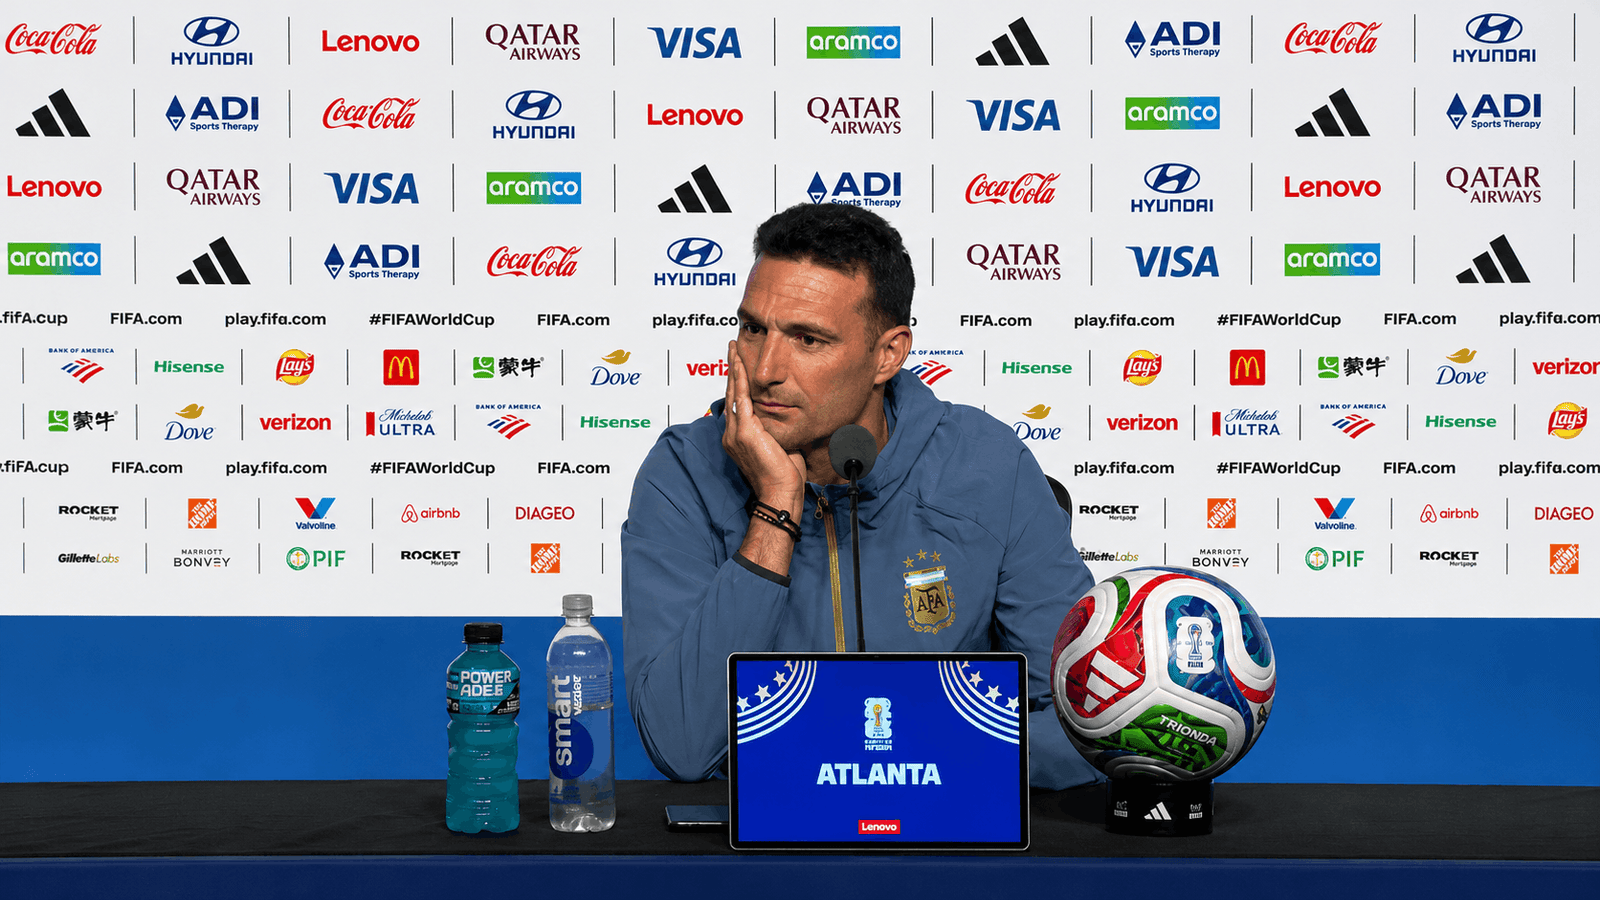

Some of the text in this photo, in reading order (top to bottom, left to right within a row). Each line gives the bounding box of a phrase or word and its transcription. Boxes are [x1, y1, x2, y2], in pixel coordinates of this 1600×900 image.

[5, 23, 102, 55] Coca-Cola
[322, 30, 420, 52] Lenovo
[486, 24, 579, 47] QATAR
[1150, 21, 1220, 46] ADI
[1285, 22, 1382, 54] Coca-Cola
[647, 27, 742, 59] VISA
[809, 34, 898, 51] aramco
[171, 52, 253, 65] HYUNDAI
[510, 48, 580, 60] AIRWAYS
[1150, 48, 1220, 58] Sports Therapy
[1453, 49, 1536, 62] HYUNDAI
[190, 96, 259, 120] ADI
[322, 98, 420, 129] Coca-Cola
[807, 97, 900, 120] QATAR
[1127, 105, 1217, 122] aramco
[1471, 94, 1541, 118] ADI
[648, 104, 743, 126] Lenovo
[966, 99, 1061, 131] VISA
[190, 122, 259, 132] Sports Therapy
[831, 121, 901, 134] AIRWAYS
[1471, 119, 1541, 129] Sports Therapy
[493, 126, 575, 139] HYUNDAI
[167, 169, 260, 192] QATAR
[831, 172, 901, 196] ADI
[1446, 166, 1541, 190] QATAR
[7, 175, 102, 197] Lenovo
[324, 172, 419, 204] VISA
[489, 179, 578, 196] aramco
[965, 173, 1061, 204] Coca-Cola
[1285, 176, 1381, 197] Lenovo
[191, 193, 260, 205] AIRWAYS
[864, 198, 902, 209] Therapy
[1470, 191, 1541, 203] AIRWAYS
[1131, 199, 1213, 212] HYUNDAI
[10, 251, 99, 268] aramco
[349, 244, 419, 268] ADI
[487, 246, 582, 277] Coca-Cola
[967, 244, 1060, 267] QATAR
[1125, 246, 1219, 277] VISA
[1287, 250, 1378, 267] aramco
[349, 270, 419, 280] Sports Therapy
[654, 273, 736, 286] HYUNDAI
[991, 268, 1061, 280] AIRWAYS
[111, 313, 182, 325] FIFA.com
[225, 313, 326, 327] play.fifa.com
[369, 313, 494, 328] #FIFAWorldCup
[538, 314, 610, 326] FIFA.com
[652, 313, 738, 328] play.fifa.co
[961, 315, 1032, 326] FIFA.com
[1075, 314, 1174, 329] play.fifa.com
[1217, 313, 1341, 328] #FIFAWorldCup
[1384, 313, 1456, 325] FIFA.com
[1500, 311, 1600, 327] play.fifa.com
[154, 361, 224, 373] Hisense
[279, 358, 313, 377] Lay's
[499, 357, 541, 378] 蒙牛
[590, 363, 640, 385] Dove
[1002, 362, 1072, 374] Hisense
[1127, 358, 1160, 378] Lay's
[1343, 357, 1386, 377] 蒙牛
[1436, 362, 1486, 385] Dove
[73, 411, 114, 431] 蒙牛
[259, 413, 331, 430] verizon
[379, 409, 433, 422] Michelob
[581, 416, 651, 428] Hisense
[1107, 414, 1178, 431] verizon
[1225, 409, 1279, 422] Michelob
[1426, 415, 1496, 427] Hisense
[1552, 412, 1585, 430] Lay's
[164, 421, 214, 440] Dove
[380, 424, 435, 436] ULTRA
[1015, 420, 1062, 441] Dove
[1226, 424, 1280, 436] ULTRA
[112, 462, 182, 473] FIFA.com
[226, 461, 327, 476] play.fifa.com
[370, 462, 495, 476] #FIFAWorldCup
[538, 462, 610, 474] FIFA.com
[1074, 462, 1174, 476] play.fifa.com
[1217, 461, 1341, 476] #FIFAWorldCup
[1384, 462, 1455, 474] FIFA.com
[1499, 461, 1600, 477] play.fifa.com
[59, 506, 119, 514] ROCKET
[421, 507, 460, 518] airbnb
[516, 506, 575, 520] DIAGEO
[1079, 505, 1139, 516] ROCKET
[1440, 508, 1479, 518] airbnb
[1535, 507, 1594, 520] DIAGEO
[296, 522, 336, 530] Valvoline
[1315, 522, 1355, 530] Valvoline
[313, 550, 346, 567] PIF
[401, 551, 461, 560] ROCKET
[1332, 551, 1364, 567] PIF
[1420, 551, 1479, 560] ROCKET
[460, 671, 512, 684] POWER
[555, 675, 572, 766] smart
[1160, 714, 1218, 747] TRIONDA
[817, 763, 942, 785] ATLANTA
[861, 822, 897, 832] Lenovo
